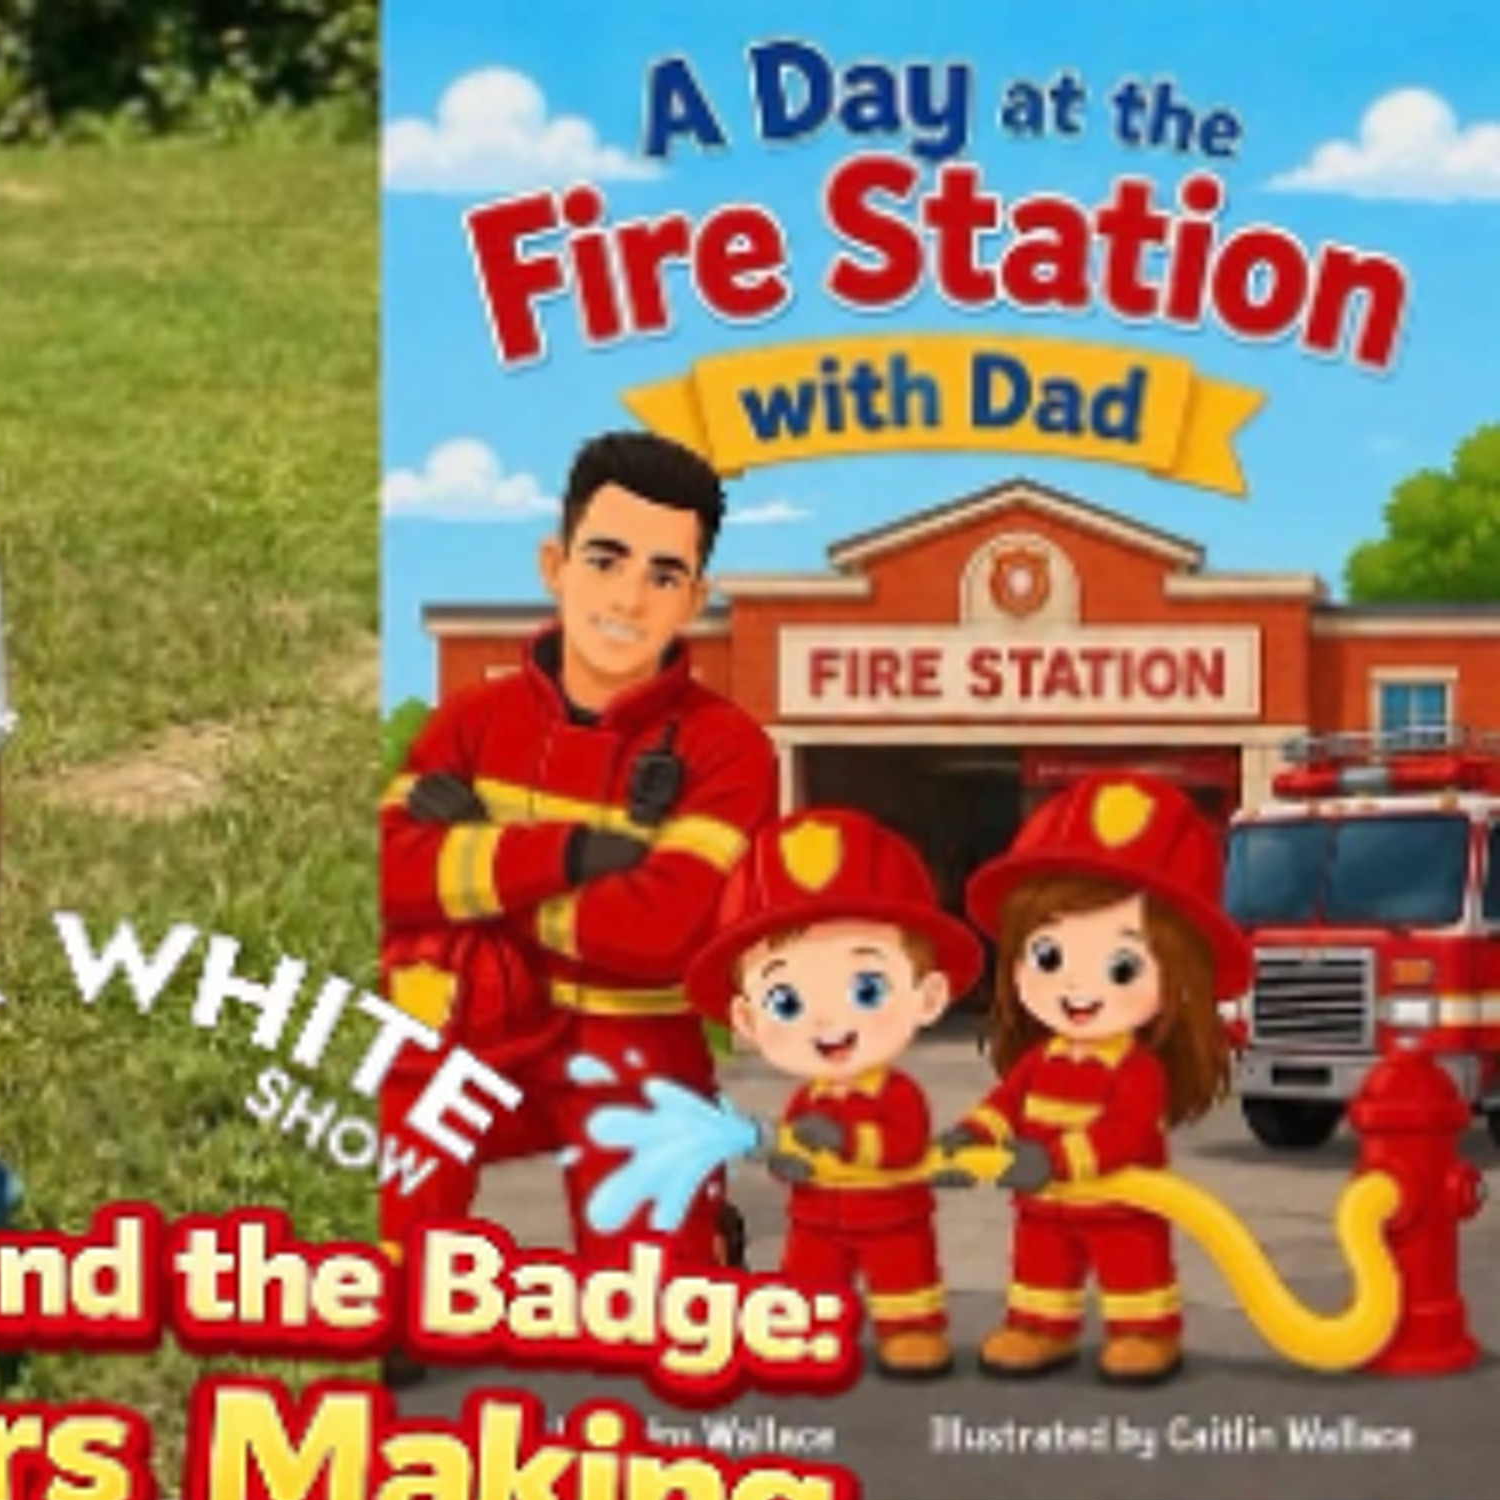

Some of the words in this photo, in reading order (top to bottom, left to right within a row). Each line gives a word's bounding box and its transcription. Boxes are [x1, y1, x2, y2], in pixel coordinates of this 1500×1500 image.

[645, 57, 726, 160] A
[749, 38, 971, 162] Day
[1001, 70, 1085, 138] at
[1113, 80, 1242, 158] the
[467, 185, 789, 361] Fire
[824, 156, 1408, 369] Station
[740, 357, 938, 440] with
[970, 354, 1148, 442] Dad
[809, 647, 940, 698] FIRE
[969, 647, 1225, 698] STATION
[700, 1415, 836, 1450] Wallace
[930, 1416, 1106, 1452] Illustrated
[1116, 1416, 1156, 1459] by
[1167, 1415, 1276, 1452] Caitlin
[1287, 1416, 1414, 1452] Wallace
